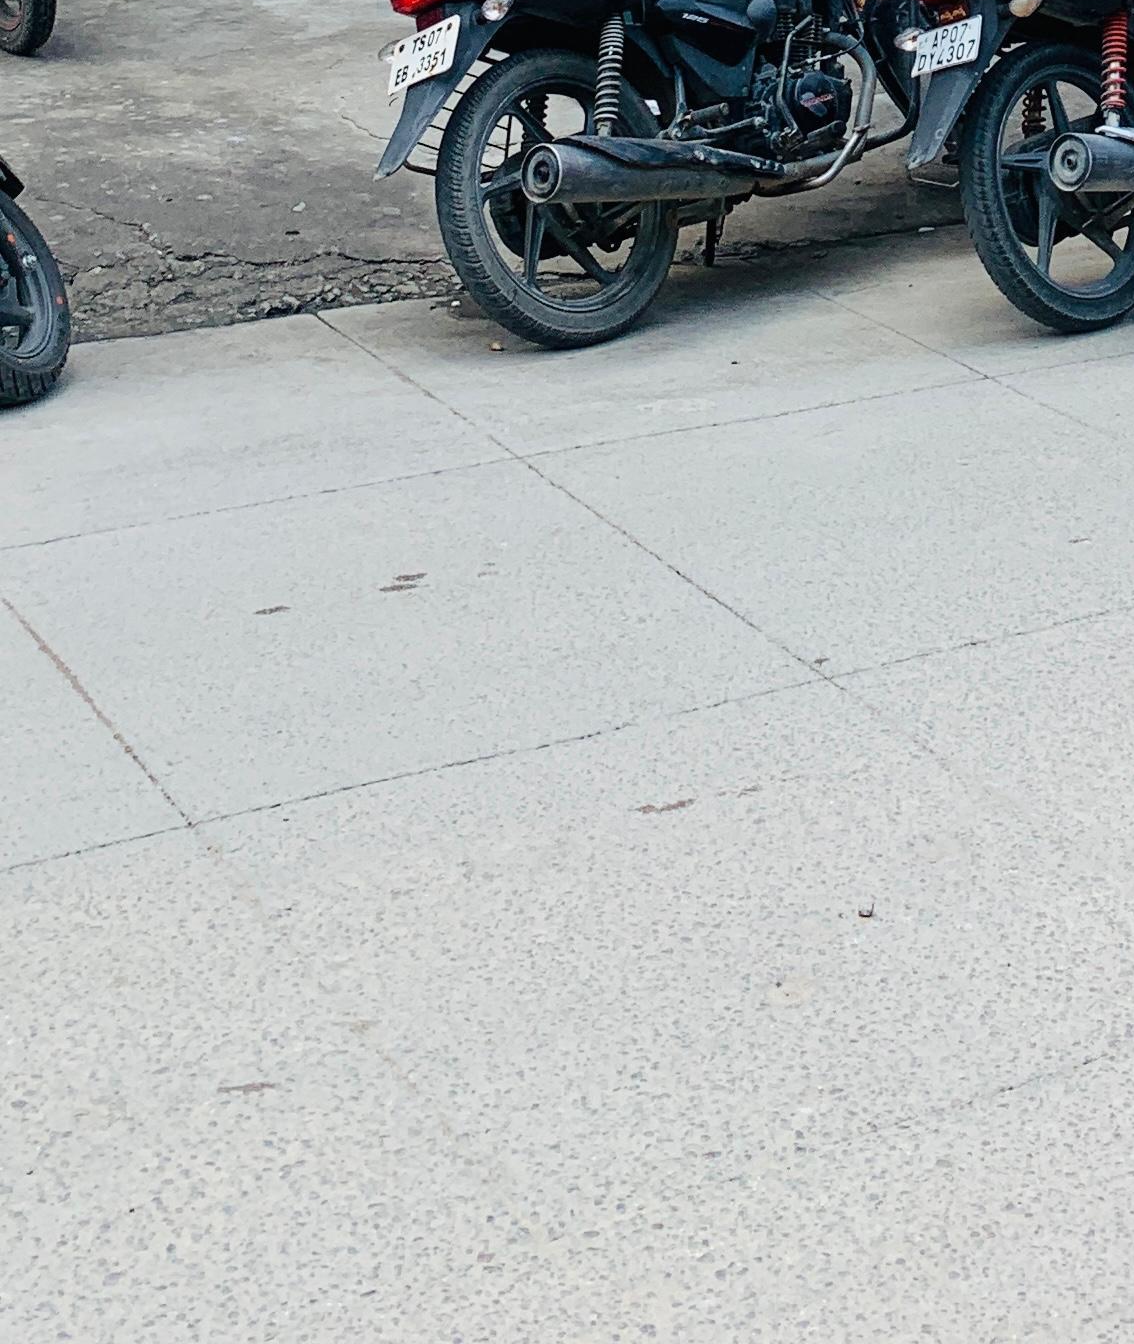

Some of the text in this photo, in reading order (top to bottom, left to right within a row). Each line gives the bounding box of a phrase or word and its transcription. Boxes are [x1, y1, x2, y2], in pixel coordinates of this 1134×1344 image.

[413, 27, 443, 54] TS07
[932, 23, 968, 48] AP07
[395, 48, 447, 86] EB 3351
[918, 39, 976, 72] DY4307
